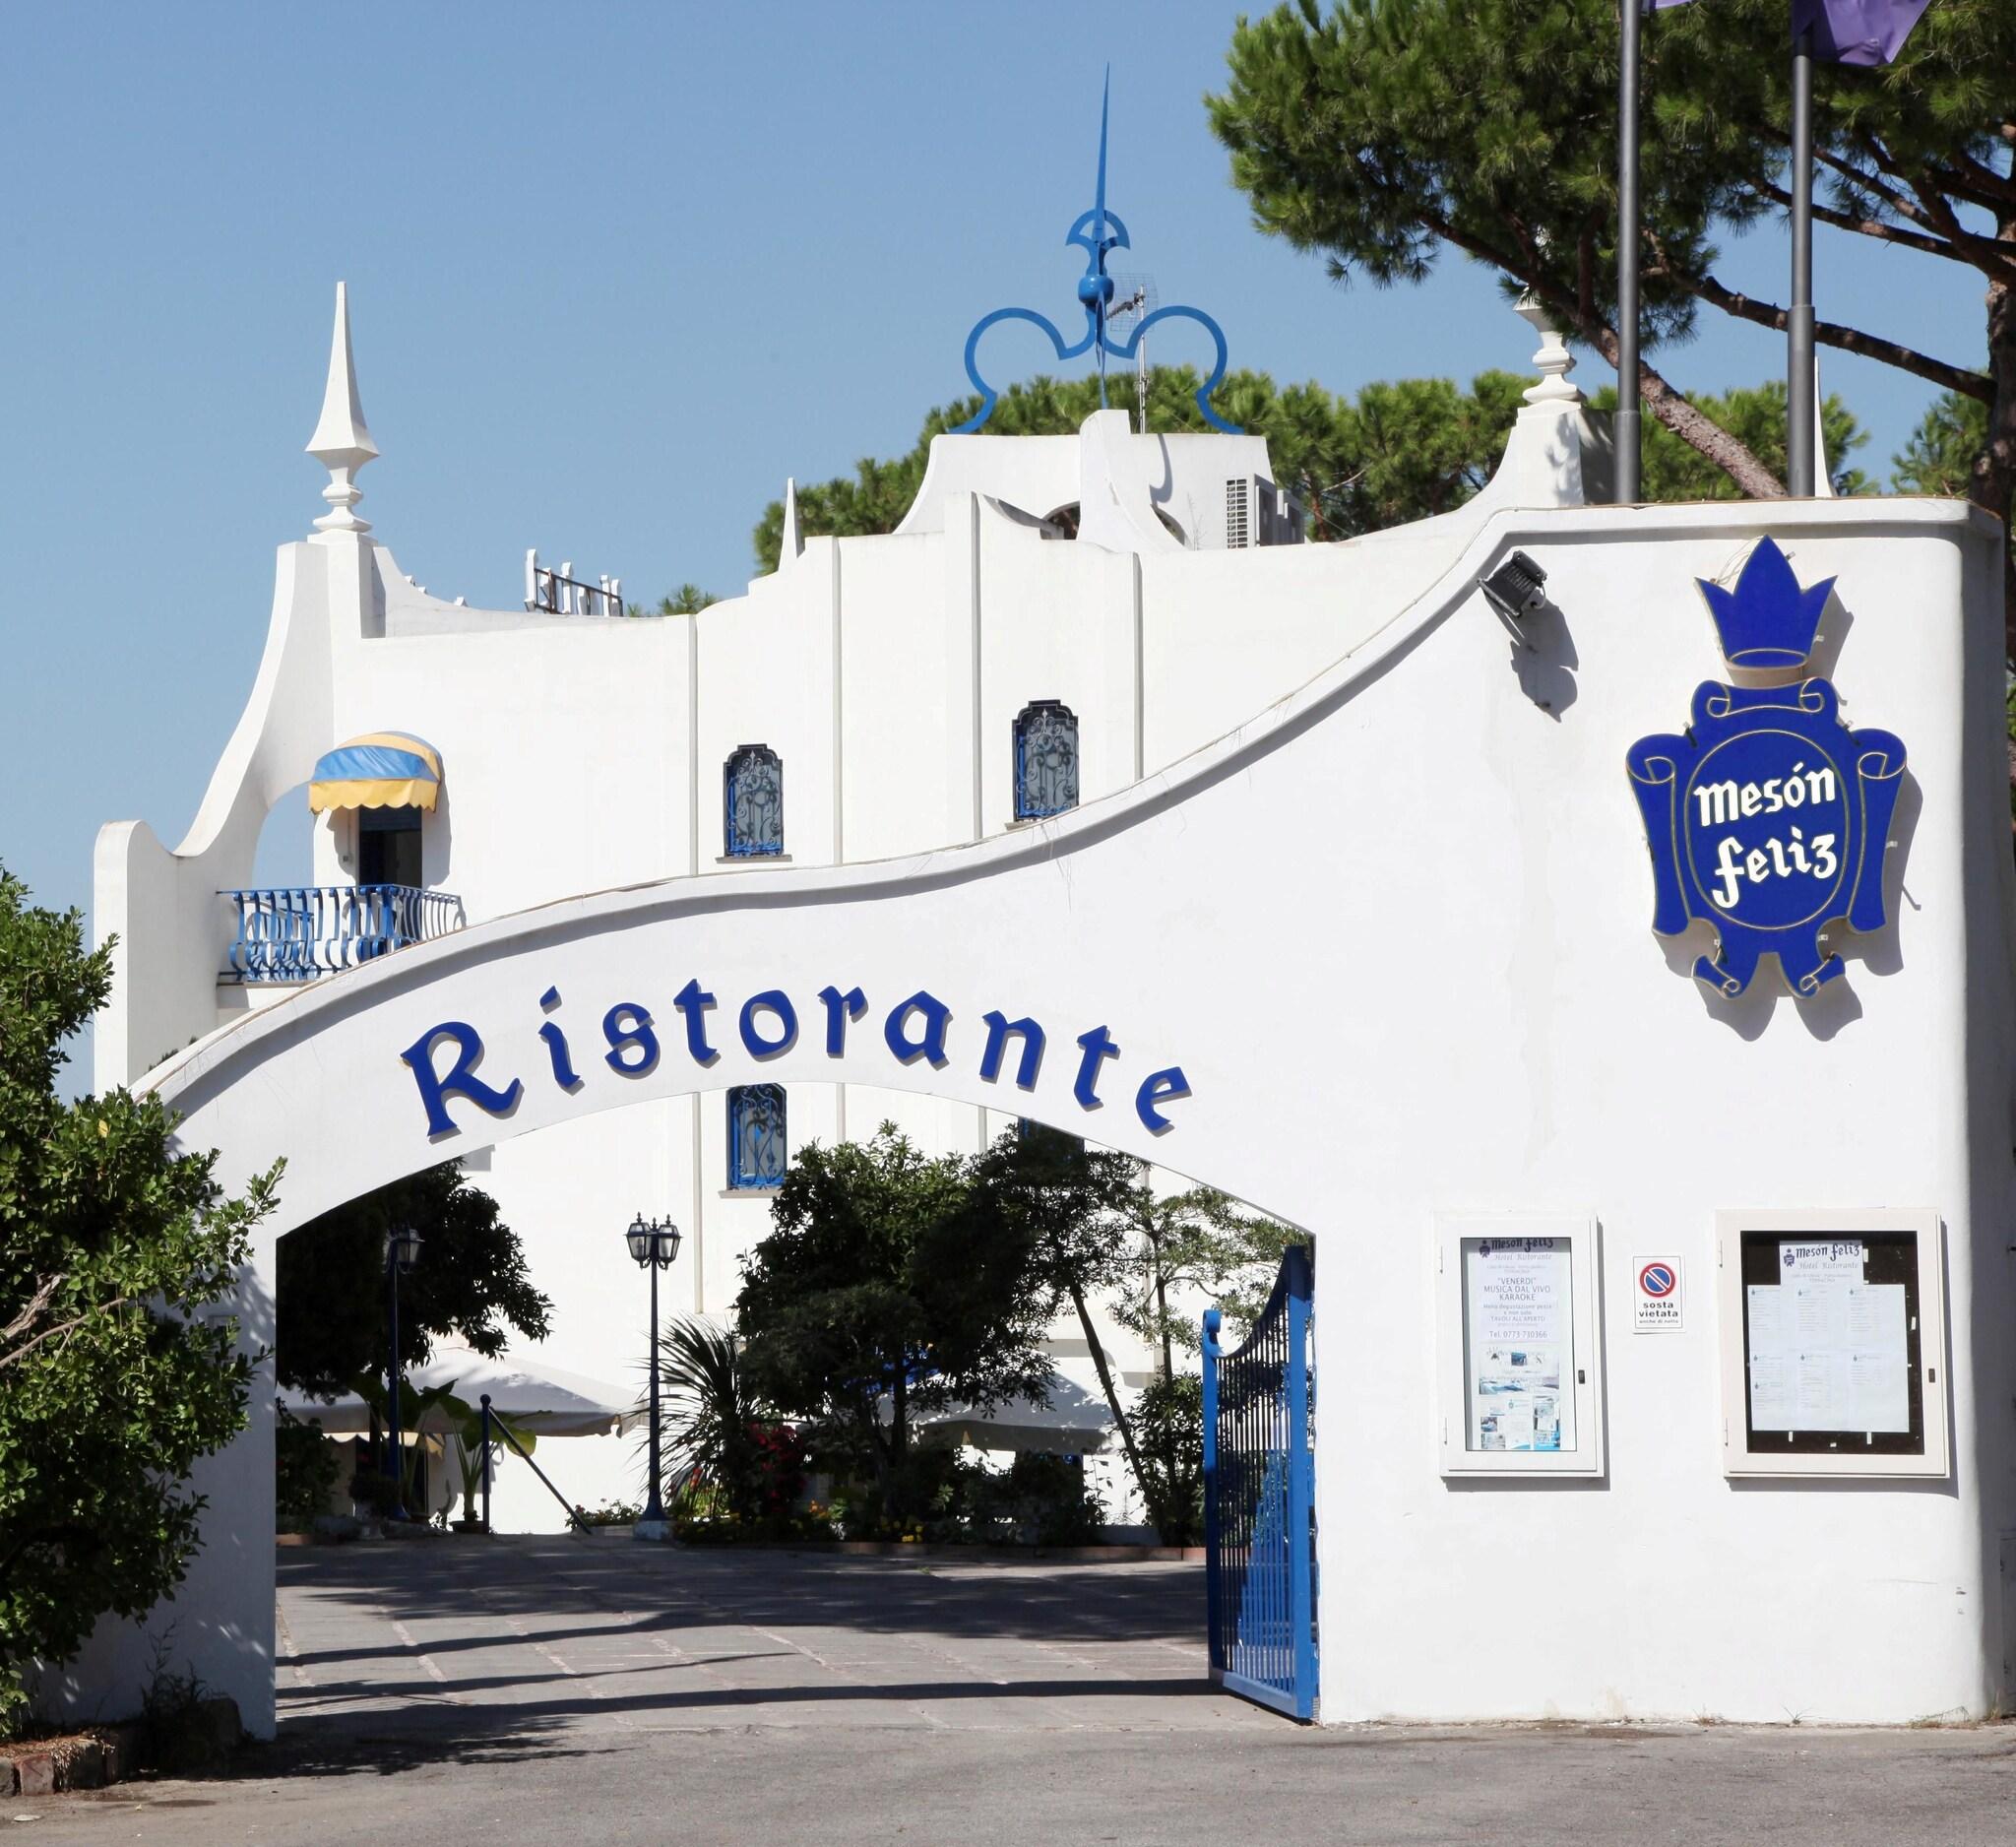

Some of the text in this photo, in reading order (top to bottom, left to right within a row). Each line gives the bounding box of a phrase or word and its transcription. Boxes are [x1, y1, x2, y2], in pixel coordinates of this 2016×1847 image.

[401, 979, 1192, 1136] Ristorante
[1483, 1285, 1512, 1294] MUSICA
[1499, 1293, 1536, 1302] KARAOKE
[1643, 1301, 1674, 1309] sosta
[1638, 1309, 1679, 1318] vietata
